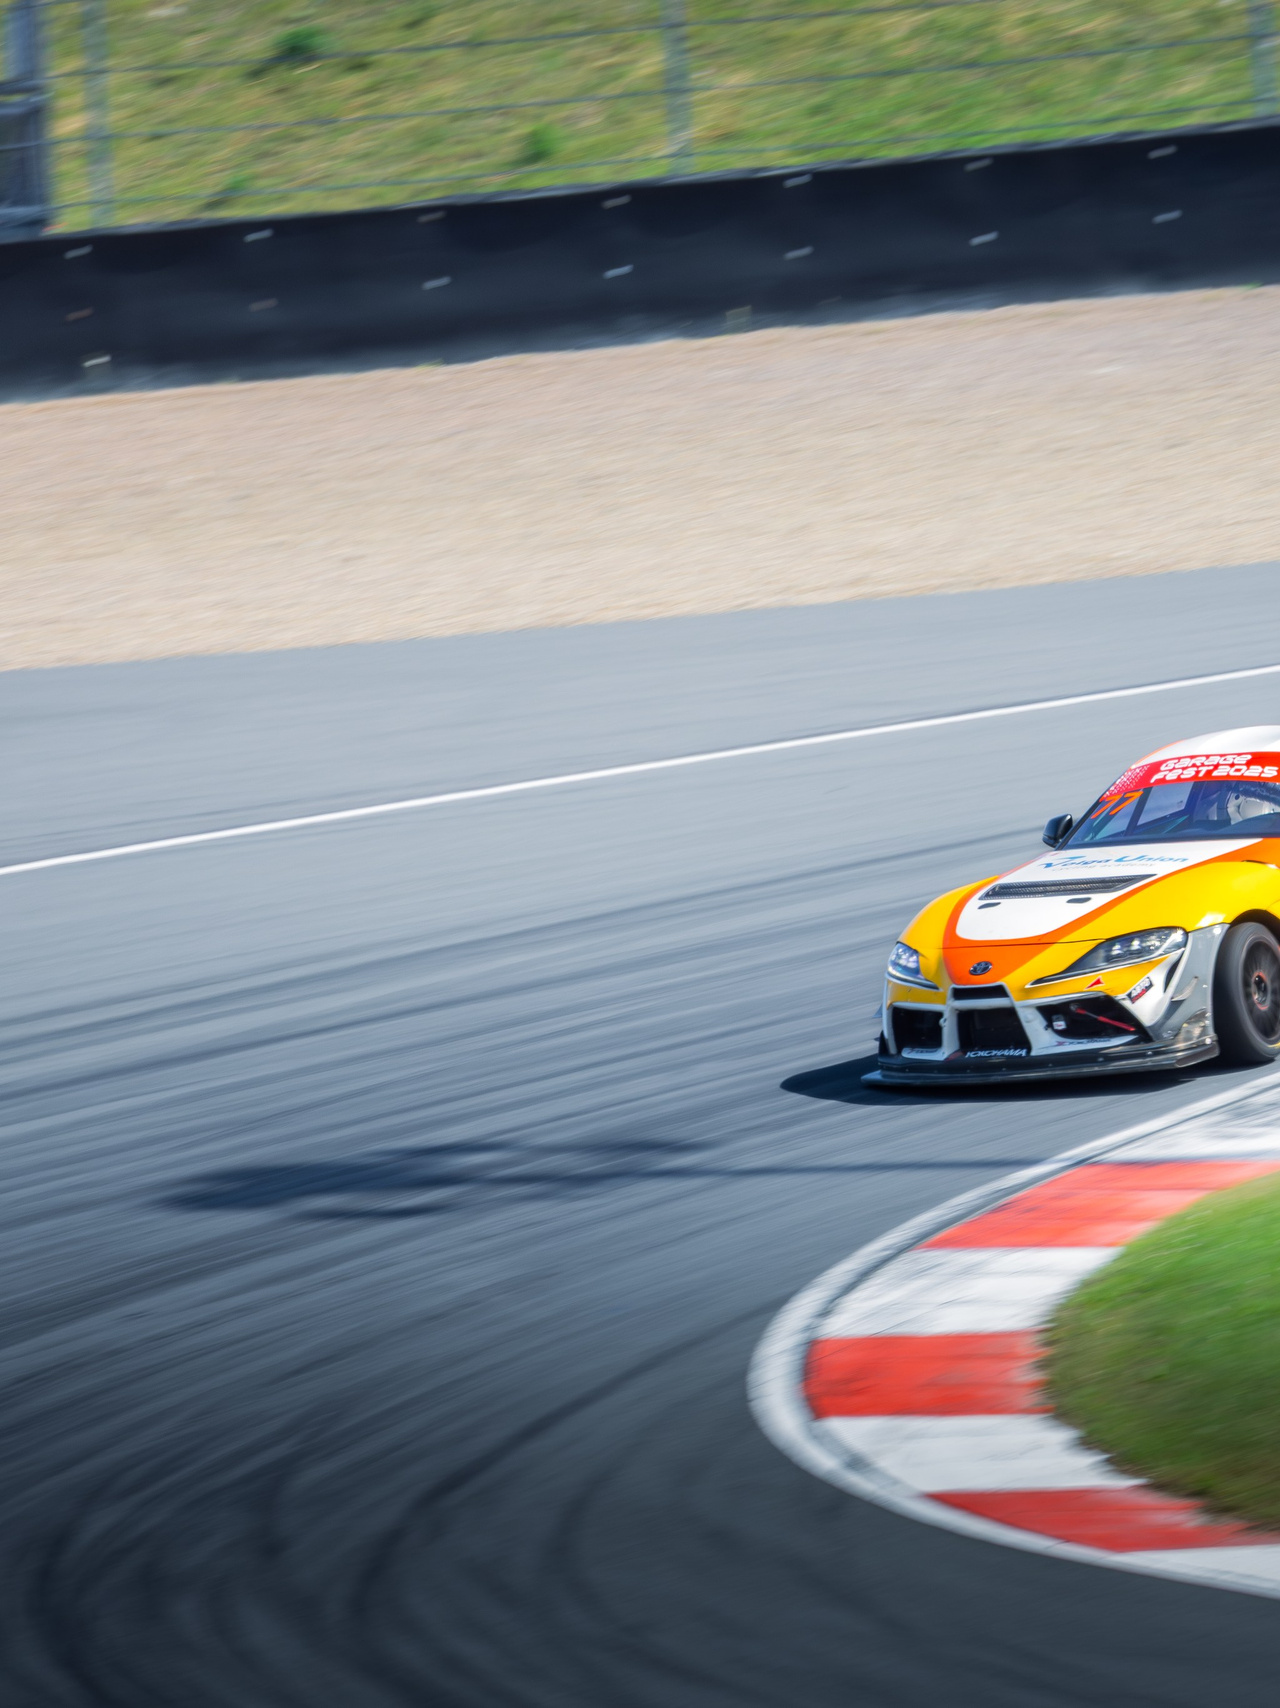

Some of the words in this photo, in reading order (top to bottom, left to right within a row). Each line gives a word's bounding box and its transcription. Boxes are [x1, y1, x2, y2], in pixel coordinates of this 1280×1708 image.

[1150, 765, 1214, 783] FEST
[1212, 765, 1279, 778] 2025
[1090, 791, 1144, 819] 77
